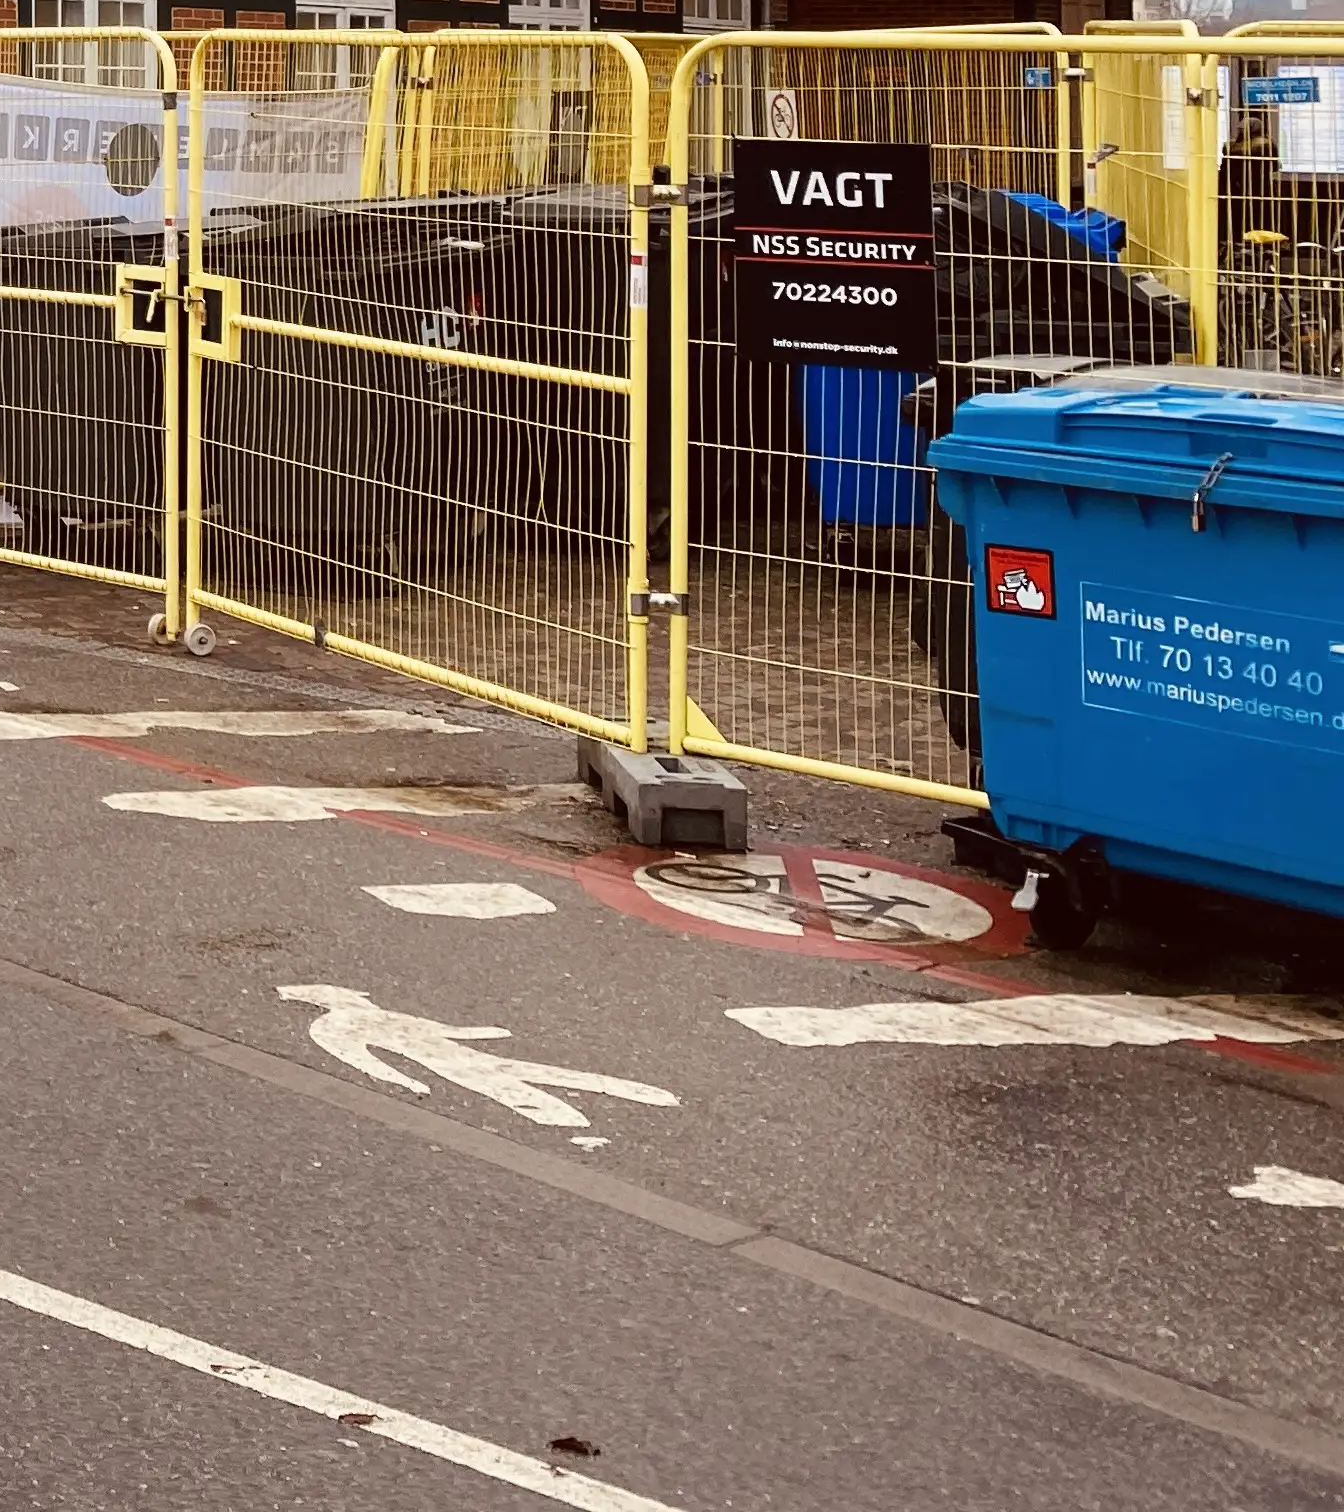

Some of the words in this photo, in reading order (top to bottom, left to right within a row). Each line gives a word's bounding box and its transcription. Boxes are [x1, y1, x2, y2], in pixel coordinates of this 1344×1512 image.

[770, 169, 893, 208] VAGT
[753, 234, 800, 256] NSS
[772, 282, 897, 306] 70224300
[1085, 600, 1166, 632] Marius
[1174, 615, 1291, 654] Pedersen
[1160, 644, 1192, 672] 70
[1203, 654, 1233, 680] 13
[1243, 662, 1277, 688] 40
[1287, 669, 1323, 696] 40
